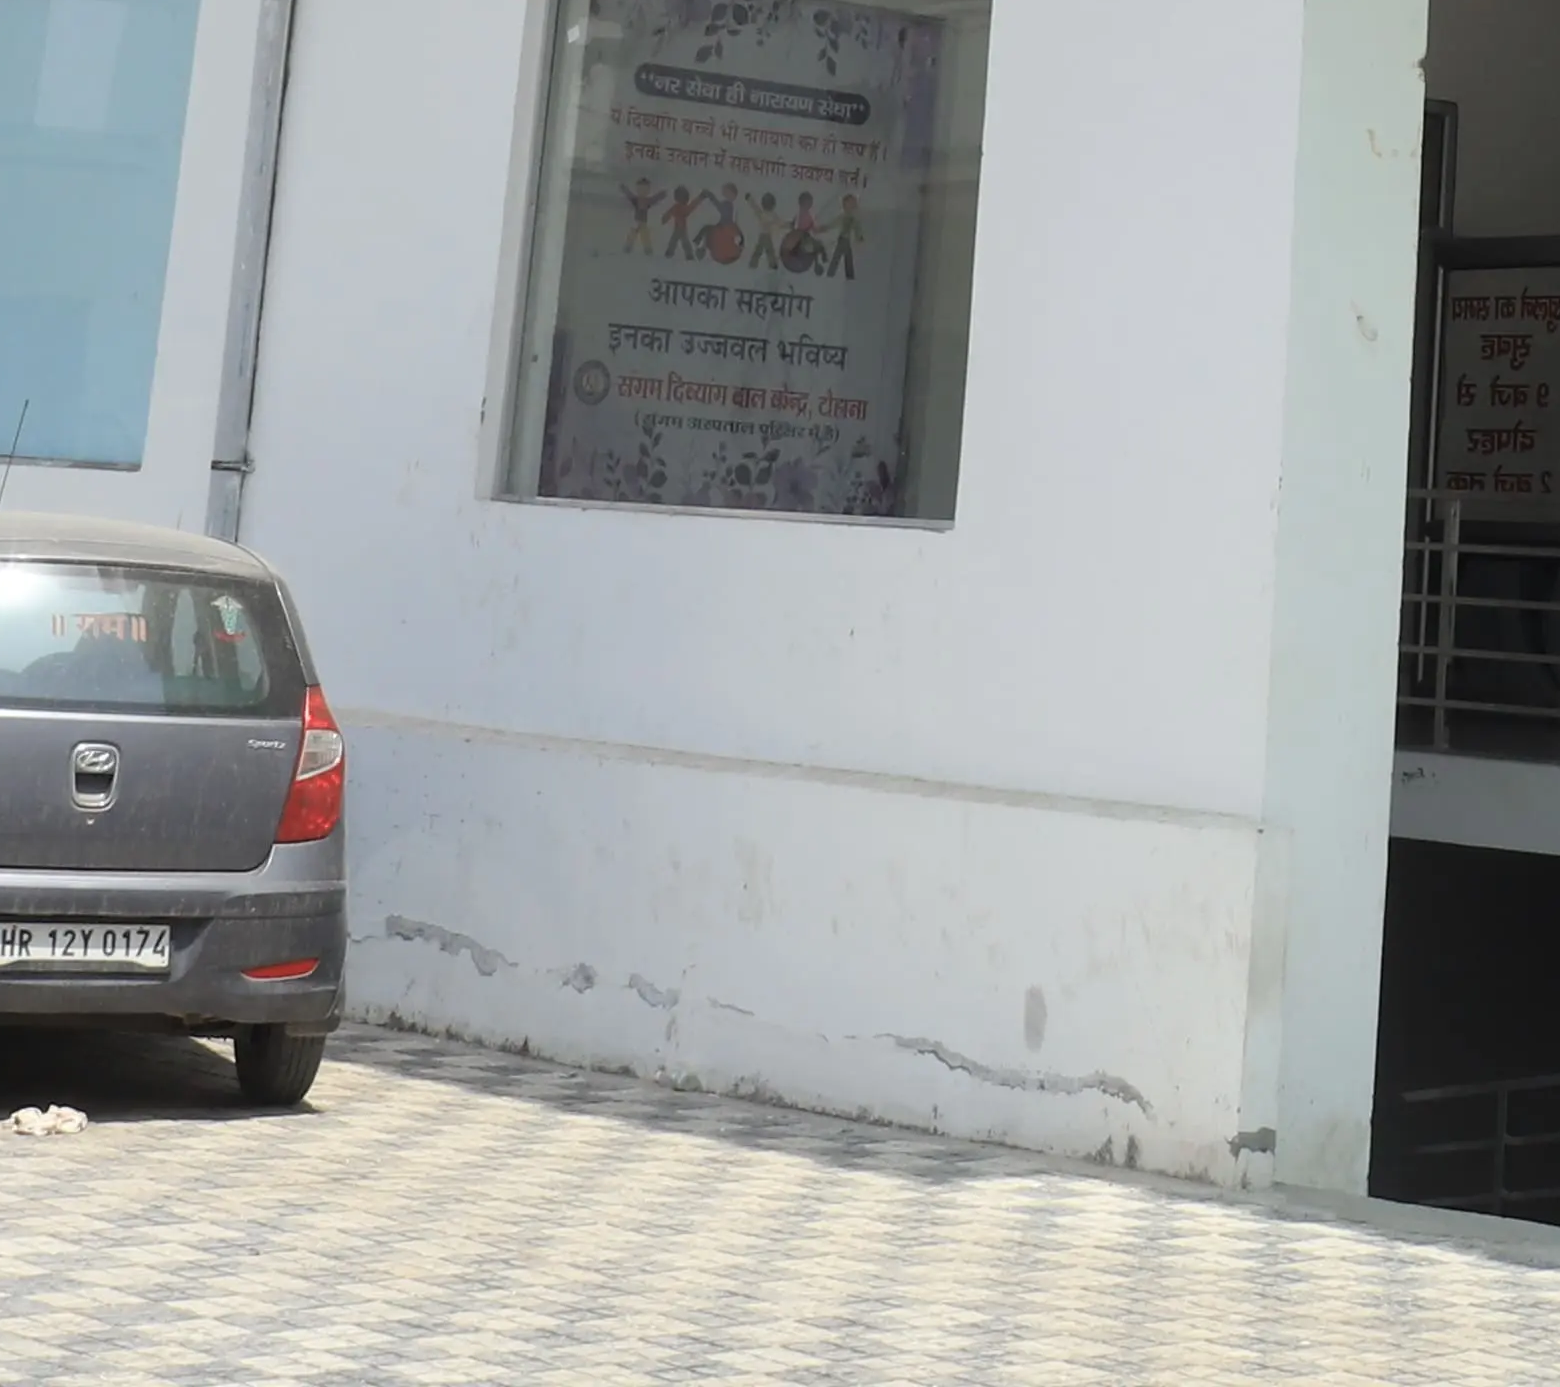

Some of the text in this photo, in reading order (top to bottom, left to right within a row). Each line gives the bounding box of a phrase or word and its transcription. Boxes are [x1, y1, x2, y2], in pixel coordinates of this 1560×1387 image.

[750, 88, 814, 112] नारायण
[648, 277, 815, 320] आपका सहयोग
[608, 322, 673, 356] इनका
[776, 332, 849, 372] भविष्य
[666, 370, 728, 406] दिव्यांग
[731, 385, 766, 410] बाल
[0, 928, 168, 958] HR 12Y 0174
